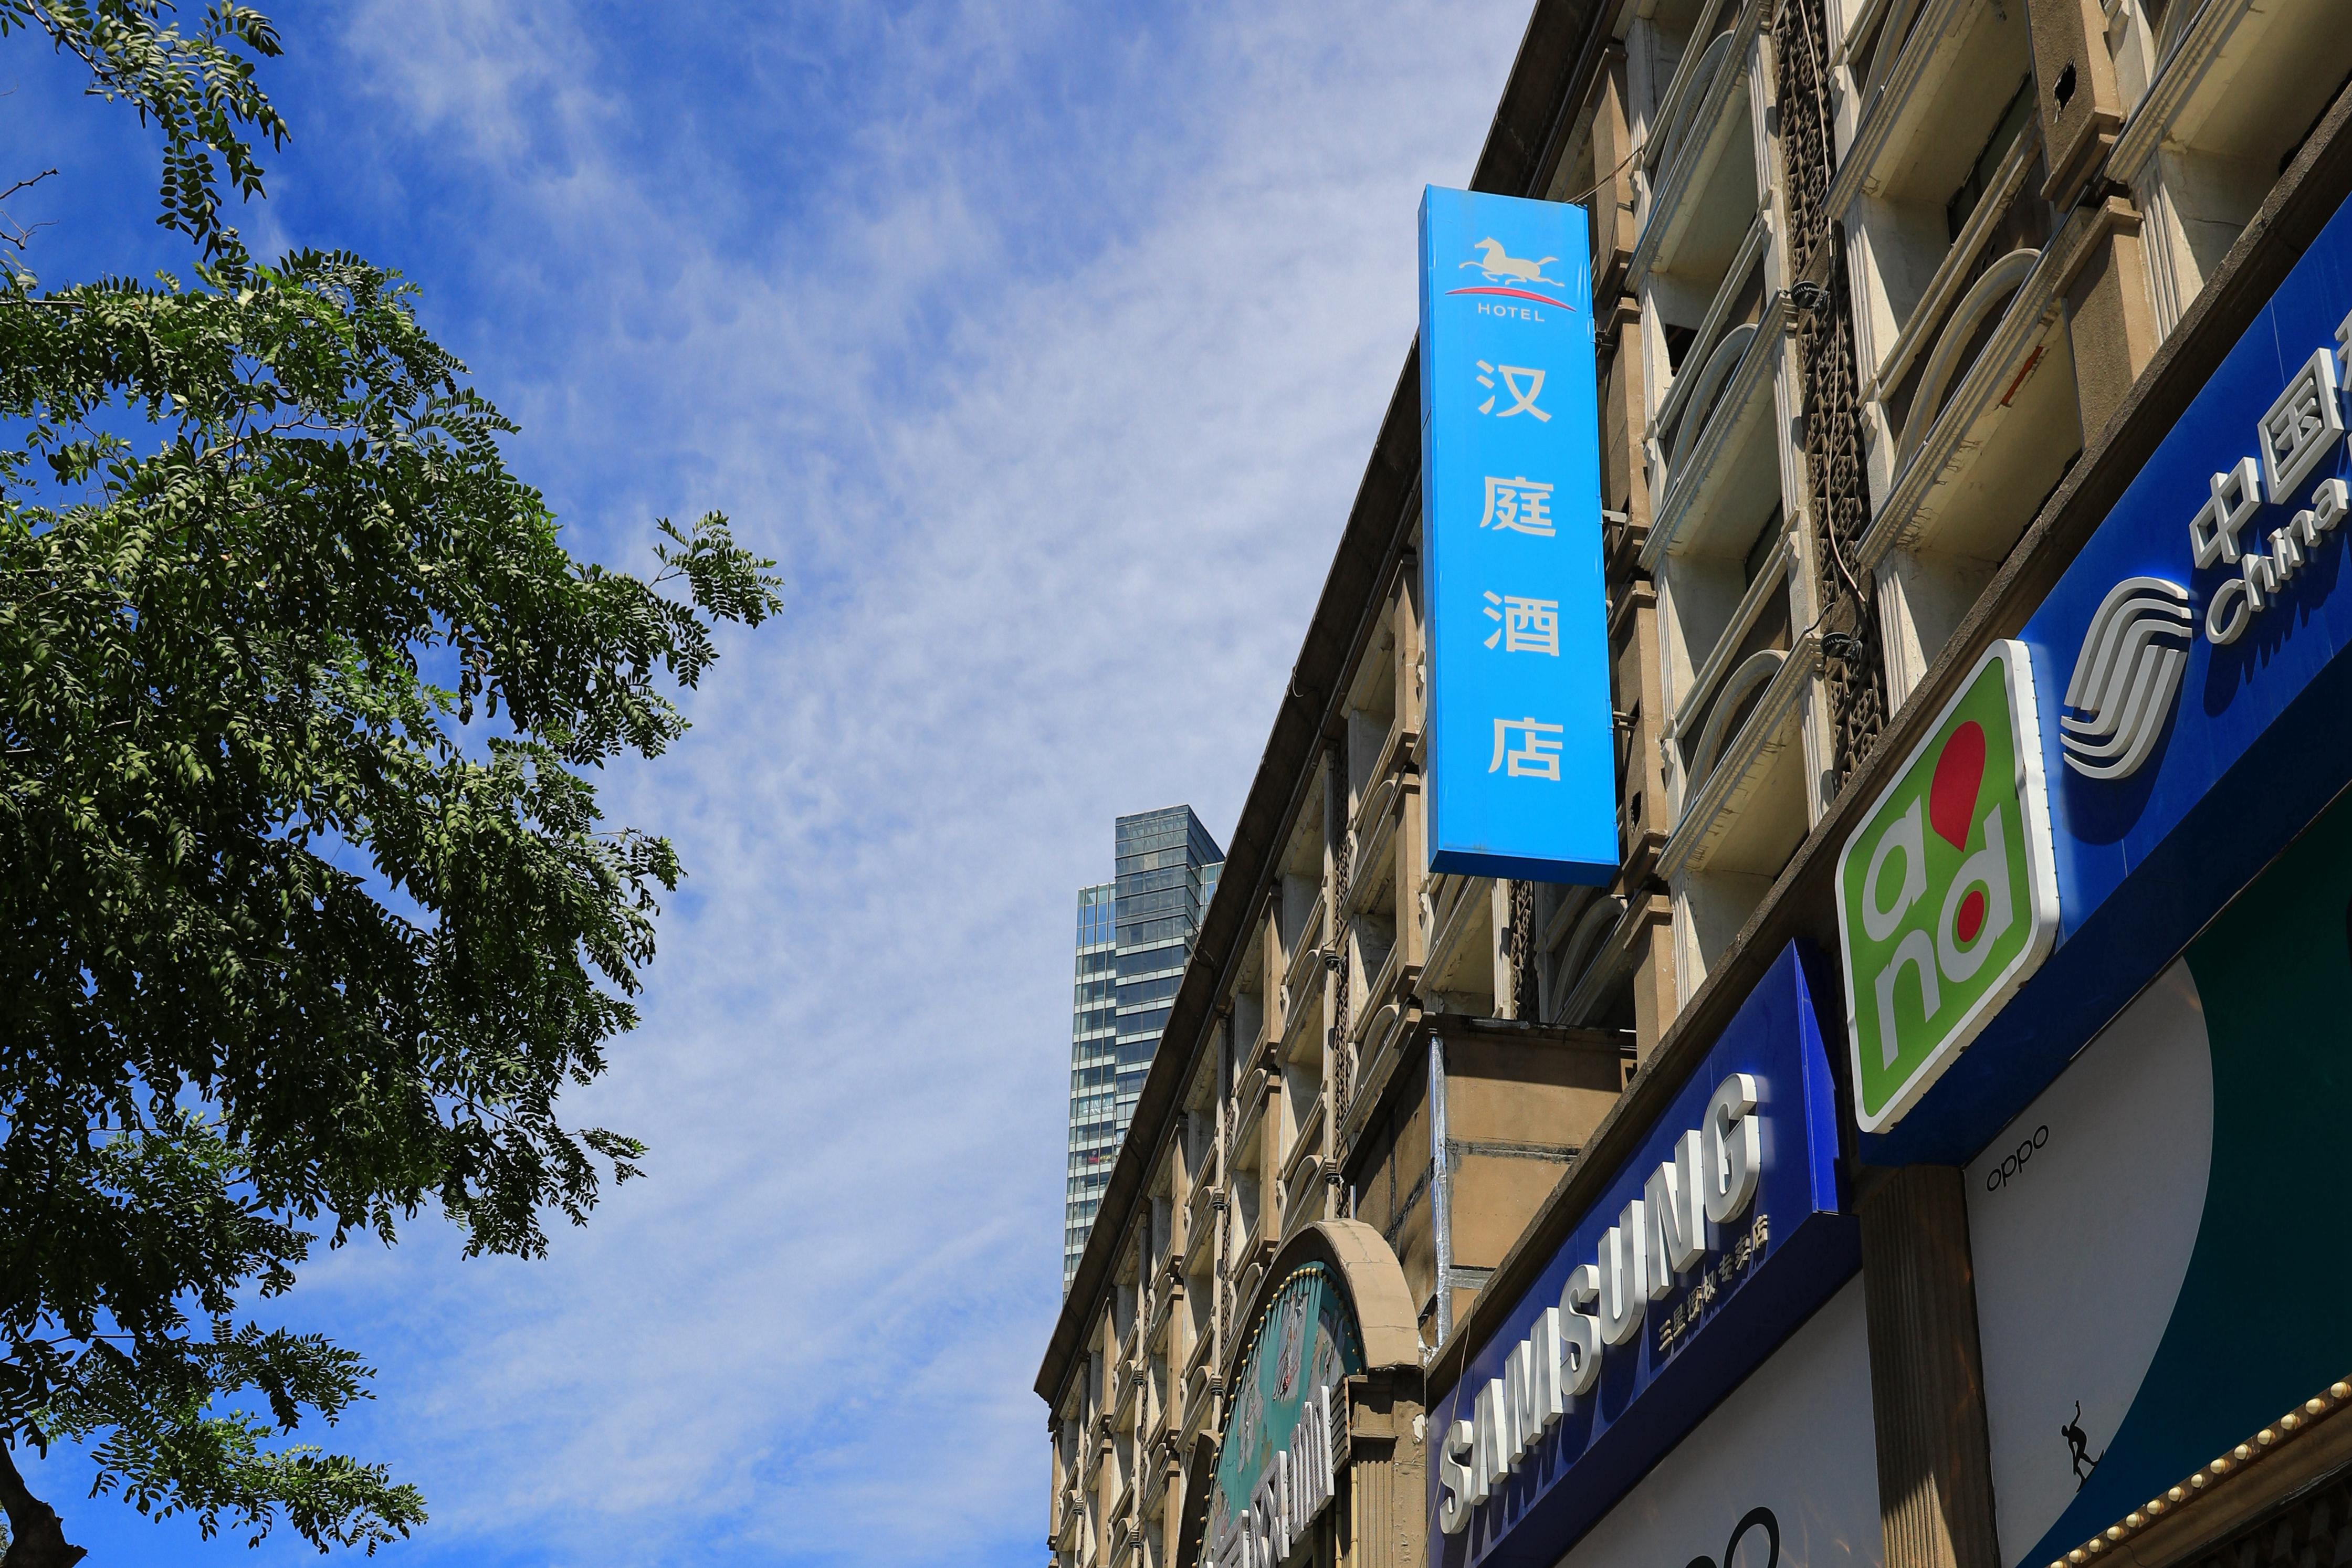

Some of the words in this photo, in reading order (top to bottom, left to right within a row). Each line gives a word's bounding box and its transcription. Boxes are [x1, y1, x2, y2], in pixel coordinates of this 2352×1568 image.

[1477, 302, 1545, 322] HOTEL
[2189, 309, 2352, 569] 中国
[1476, 359, 1563, 781] 汉庭酒店
[2206, 478, 2349, 645] China
[1438, 1072, 1761, 1535] SAMSUNG
[1658, 1214, 1768, 1352] 三星授权专卖店
